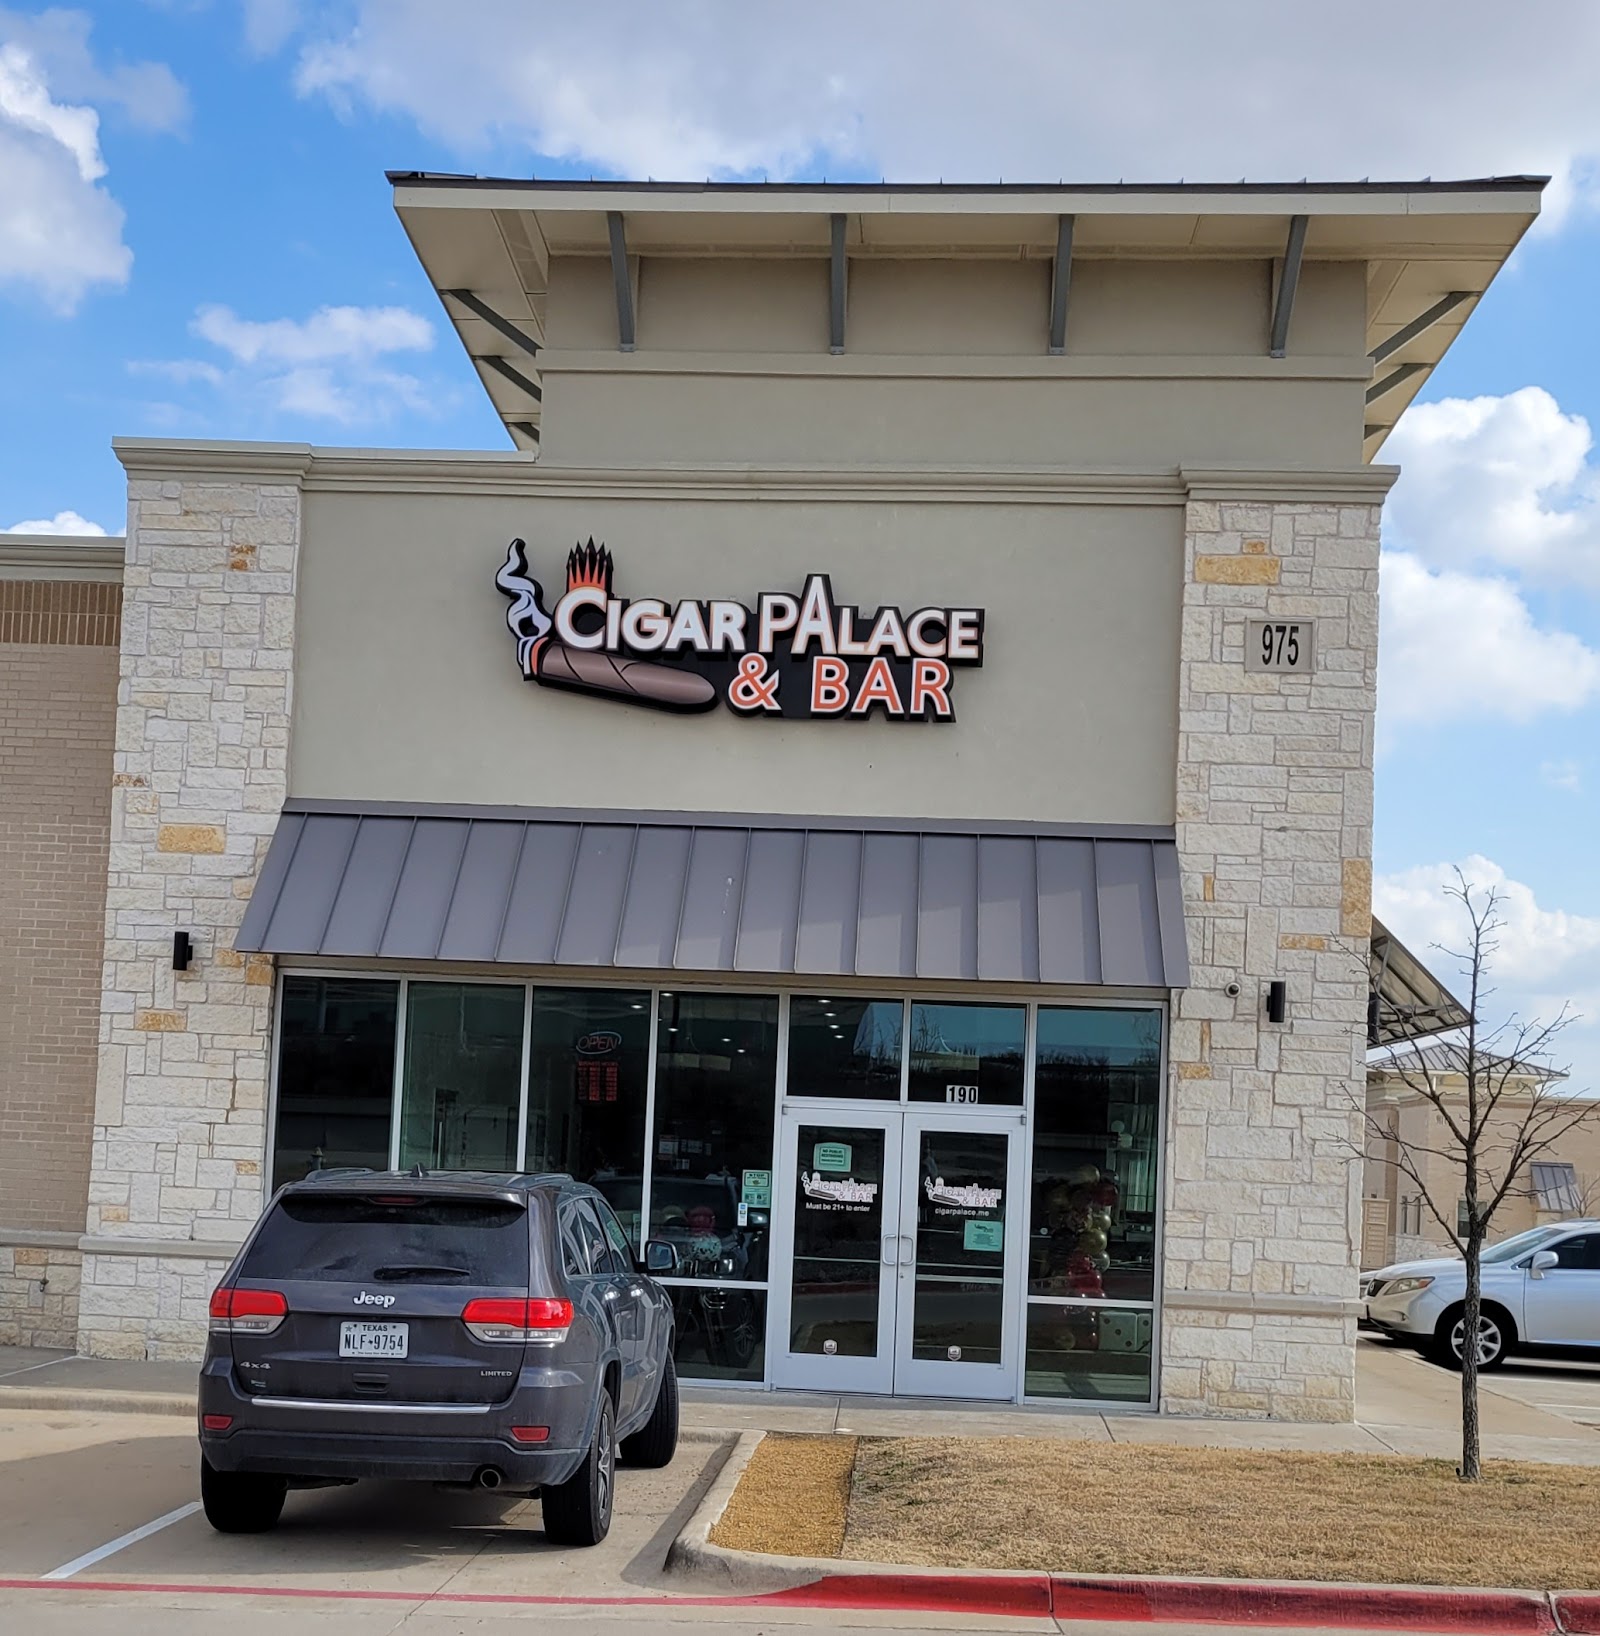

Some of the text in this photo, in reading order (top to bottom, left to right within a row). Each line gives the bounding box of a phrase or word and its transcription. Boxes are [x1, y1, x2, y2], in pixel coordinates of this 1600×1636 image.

[555, 575, 980, 659] CIGAR PALACE
[1262, 624, 1299, 666] 975
[728, 652, 951, 717] & BAR
[577, 1035, 618, 1050] OPEN
[948, 1086, 977, 1103] 190
[812, 1180, 841, 1192] CIGAR
[934, 1186, 964, 1197] CIGAR
[851, 1192, 872, 1200] BAR
[975, 1197, 997, 1206] BAR
[805, 1202, 822, 1210] Must
[832, 1203, 845, 1211] 21+
[846, 1204, 853, 1212] to
[934, 1207, 990, 1216] cigarpalace.me
[353, 1291, 396, 1308] Jeep
[362, 1324, 388, 1332] TEXAS
[240, 1361, 271, 1369] 4x4
